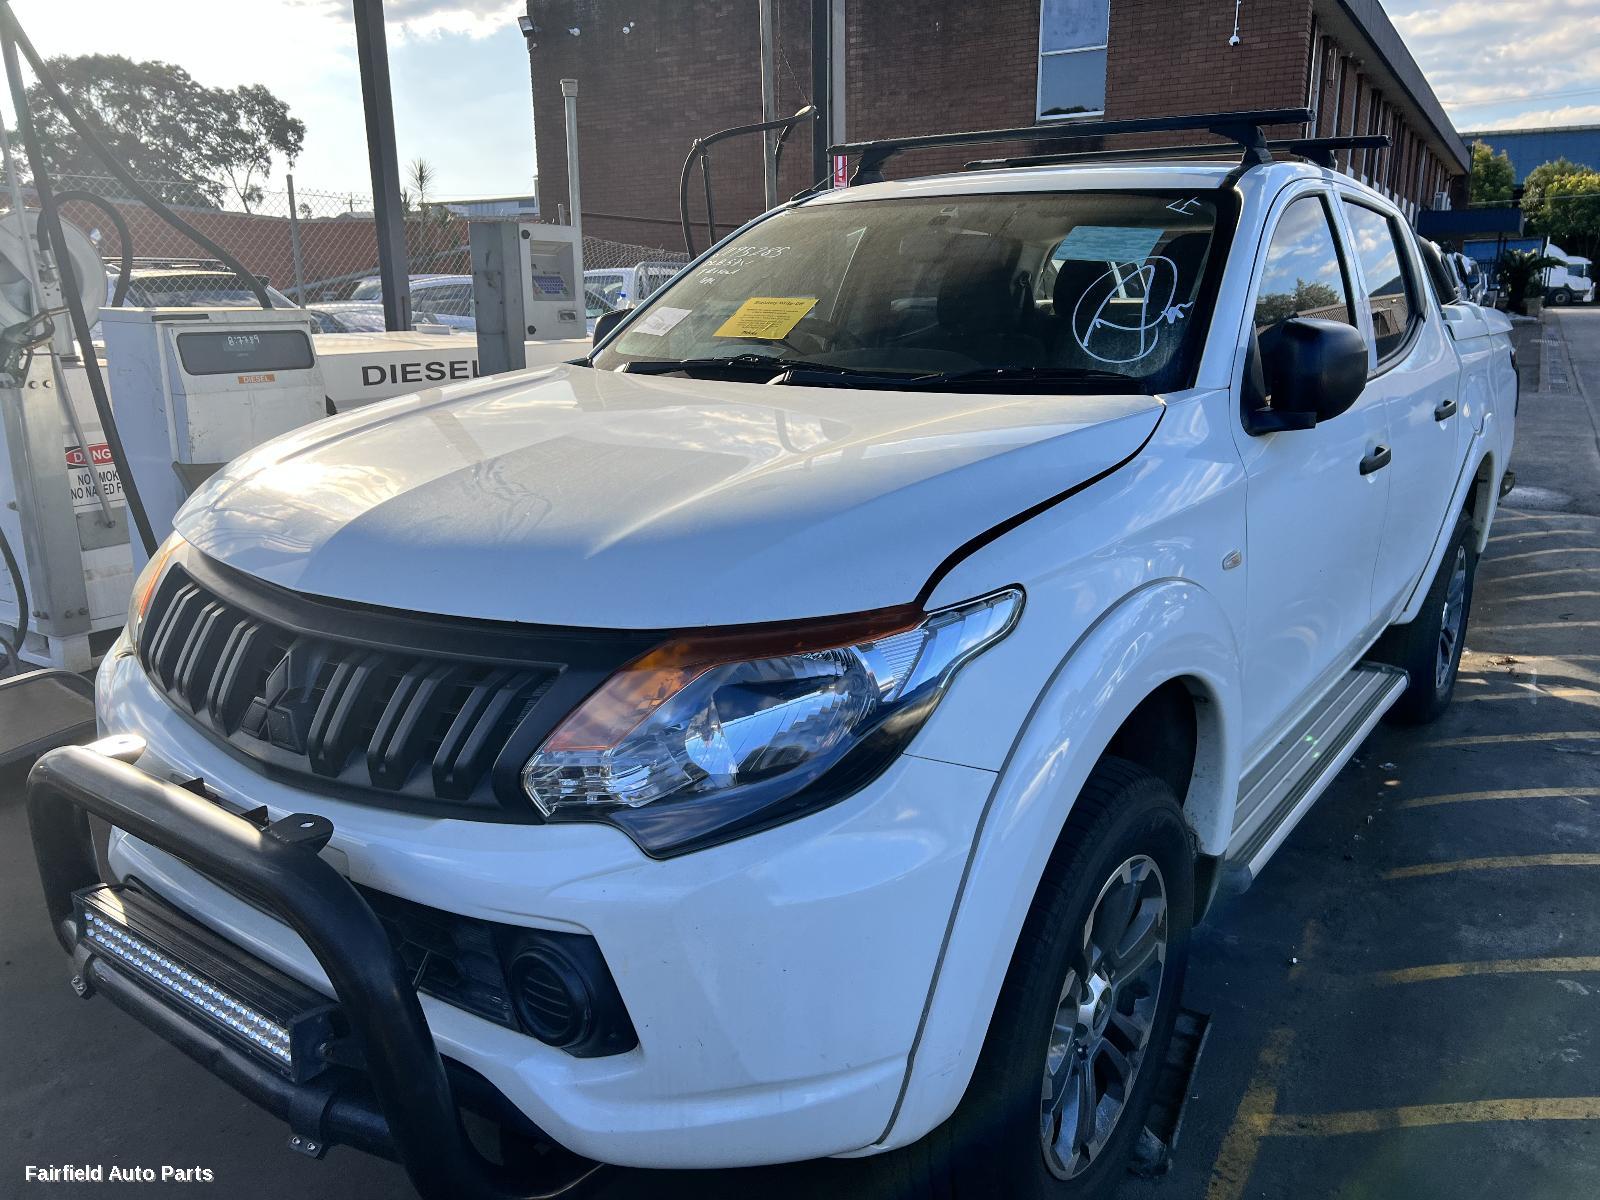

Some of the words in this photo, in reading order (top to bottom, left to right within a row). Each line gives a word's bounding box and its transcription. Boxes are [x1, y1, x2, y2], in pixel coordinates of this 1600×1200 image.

[242, 374, 270, 384] DIESEL
[361, 360, 480, 386] DIESEL
[74, 448, 112, 463] DNG
[77, 474, 91, 486] NO
[70, 488, 84, 500] NO
[86, 484, 115, 496] NAED
